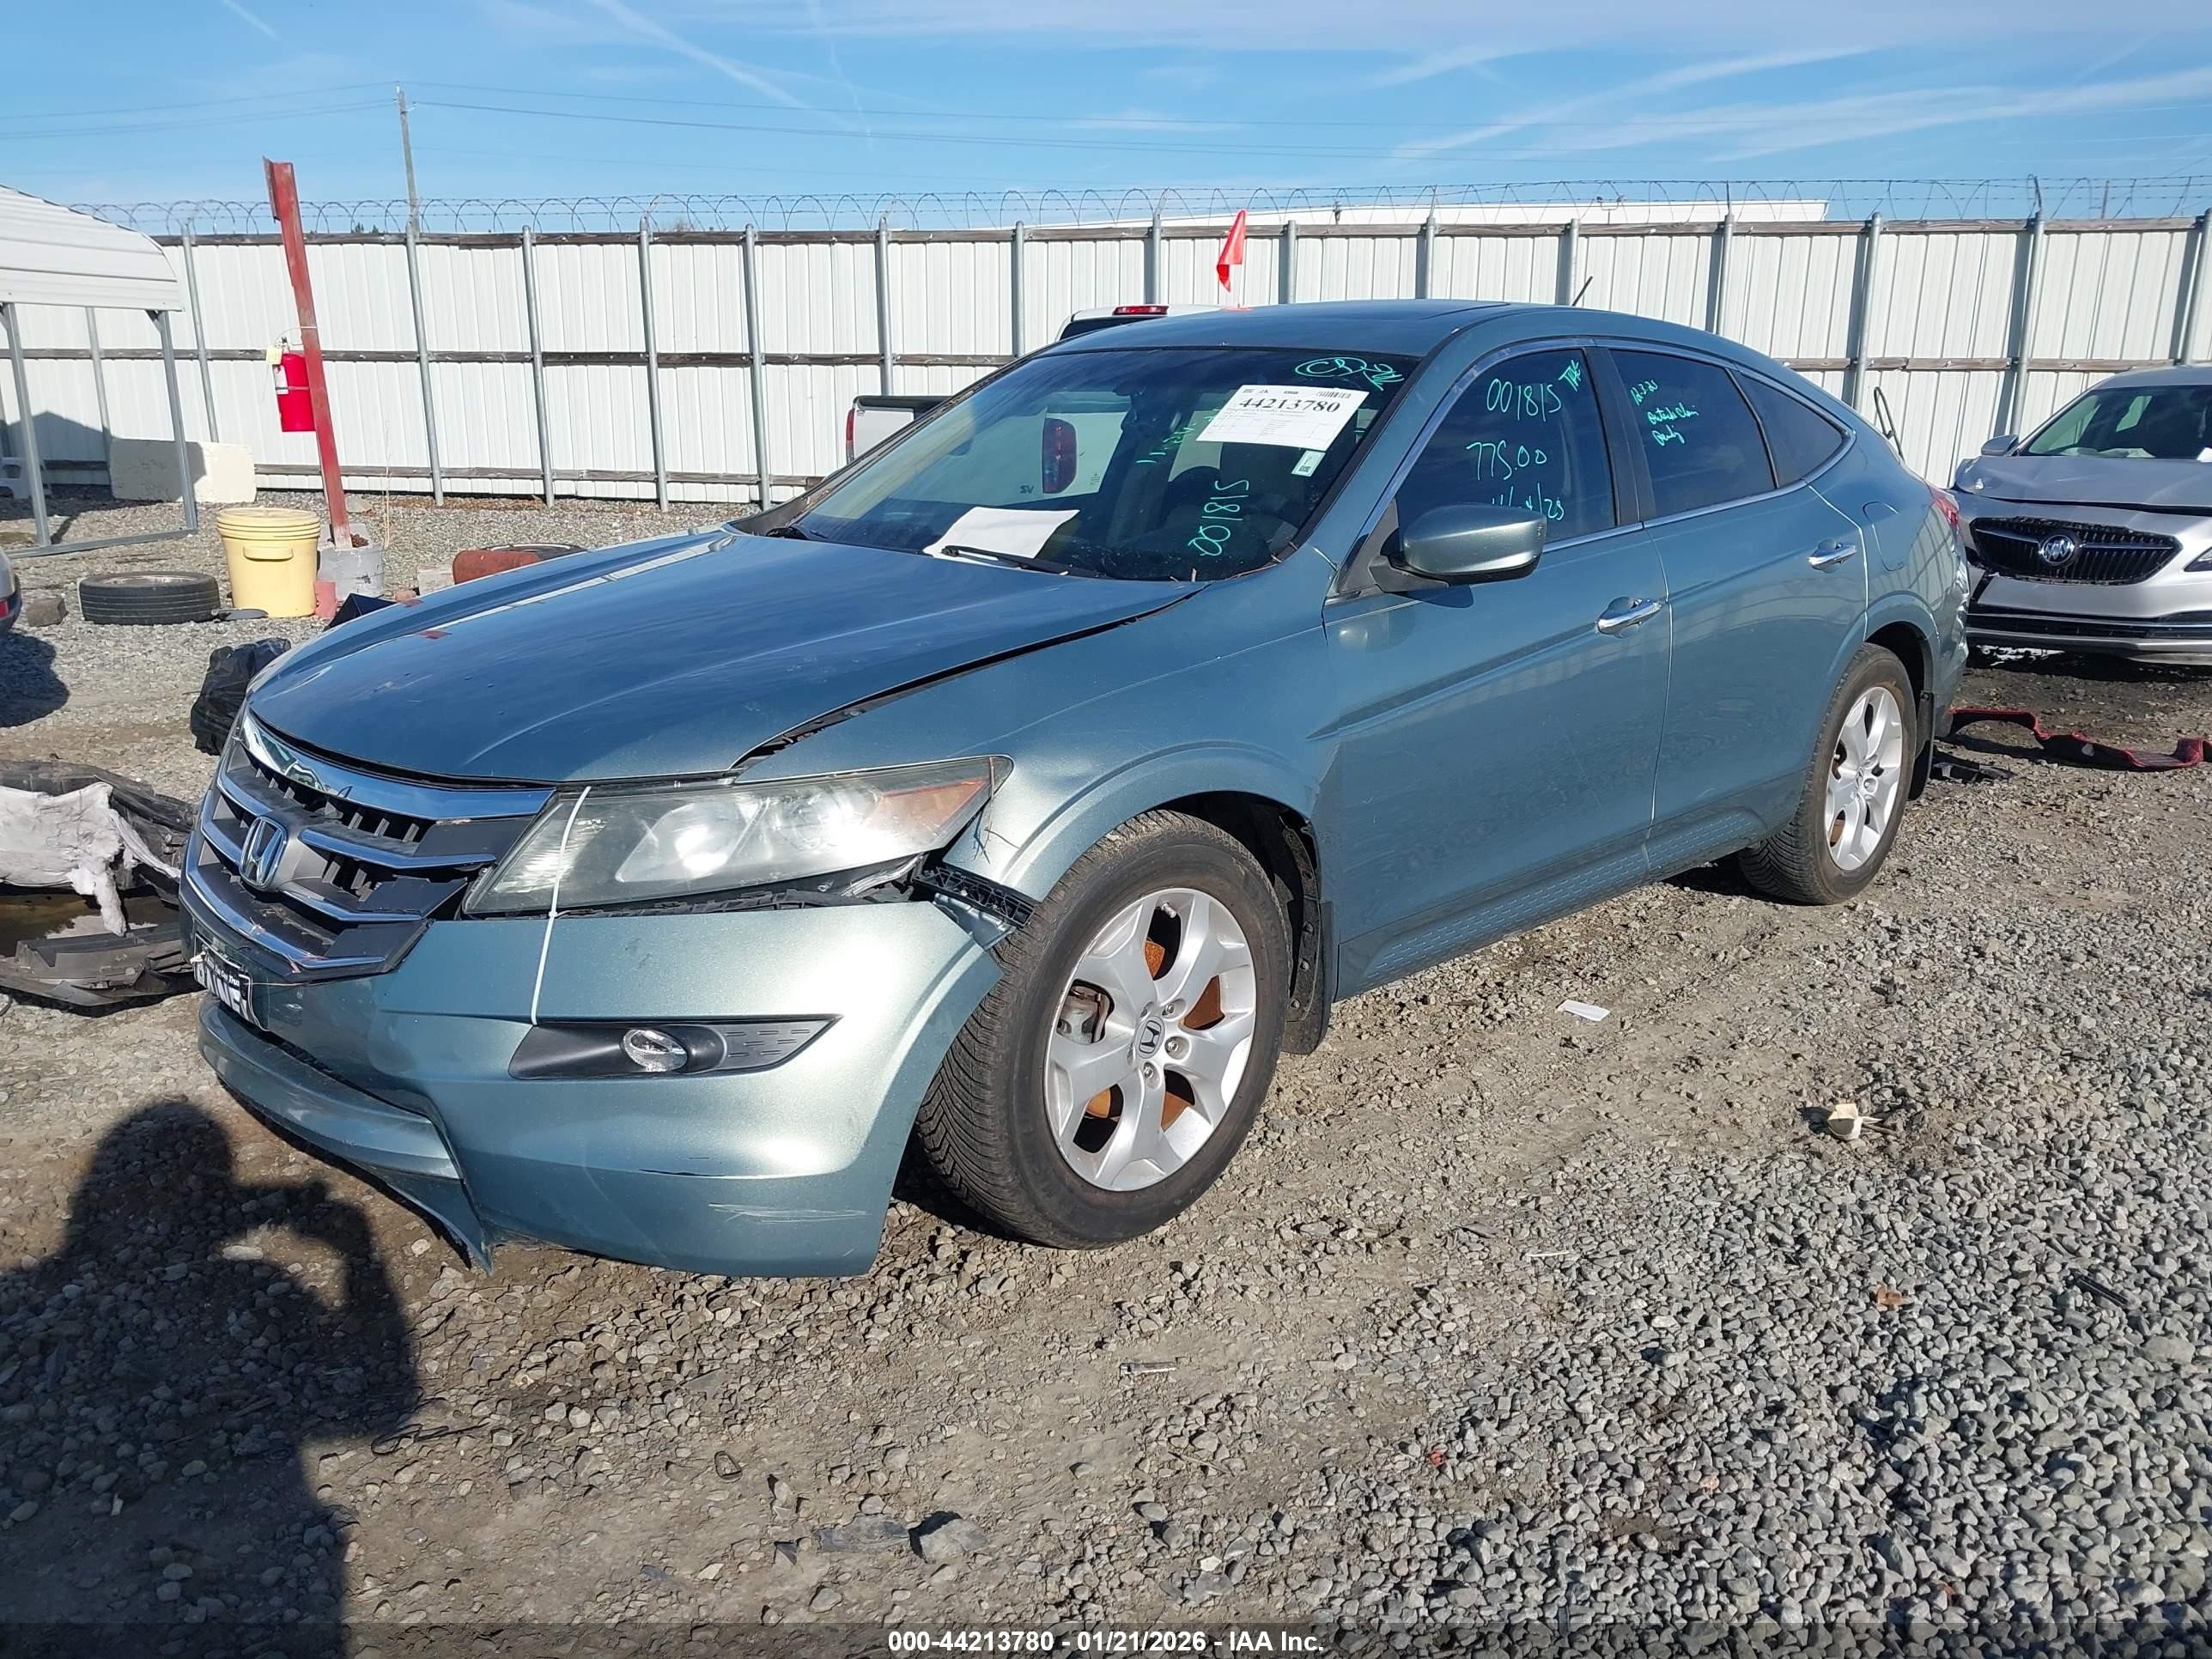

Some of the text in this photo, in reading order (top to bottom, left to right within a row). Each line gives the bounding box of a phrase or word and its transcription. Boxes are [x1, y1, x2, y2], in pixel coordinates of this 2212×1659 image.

[1239, 397, 1341, 413] 44213780
[1486, 378, 1562, 422] 001815
[1466, 440, 1547, 481] 775.00
[1188, 479, 1250, 556] 001815
